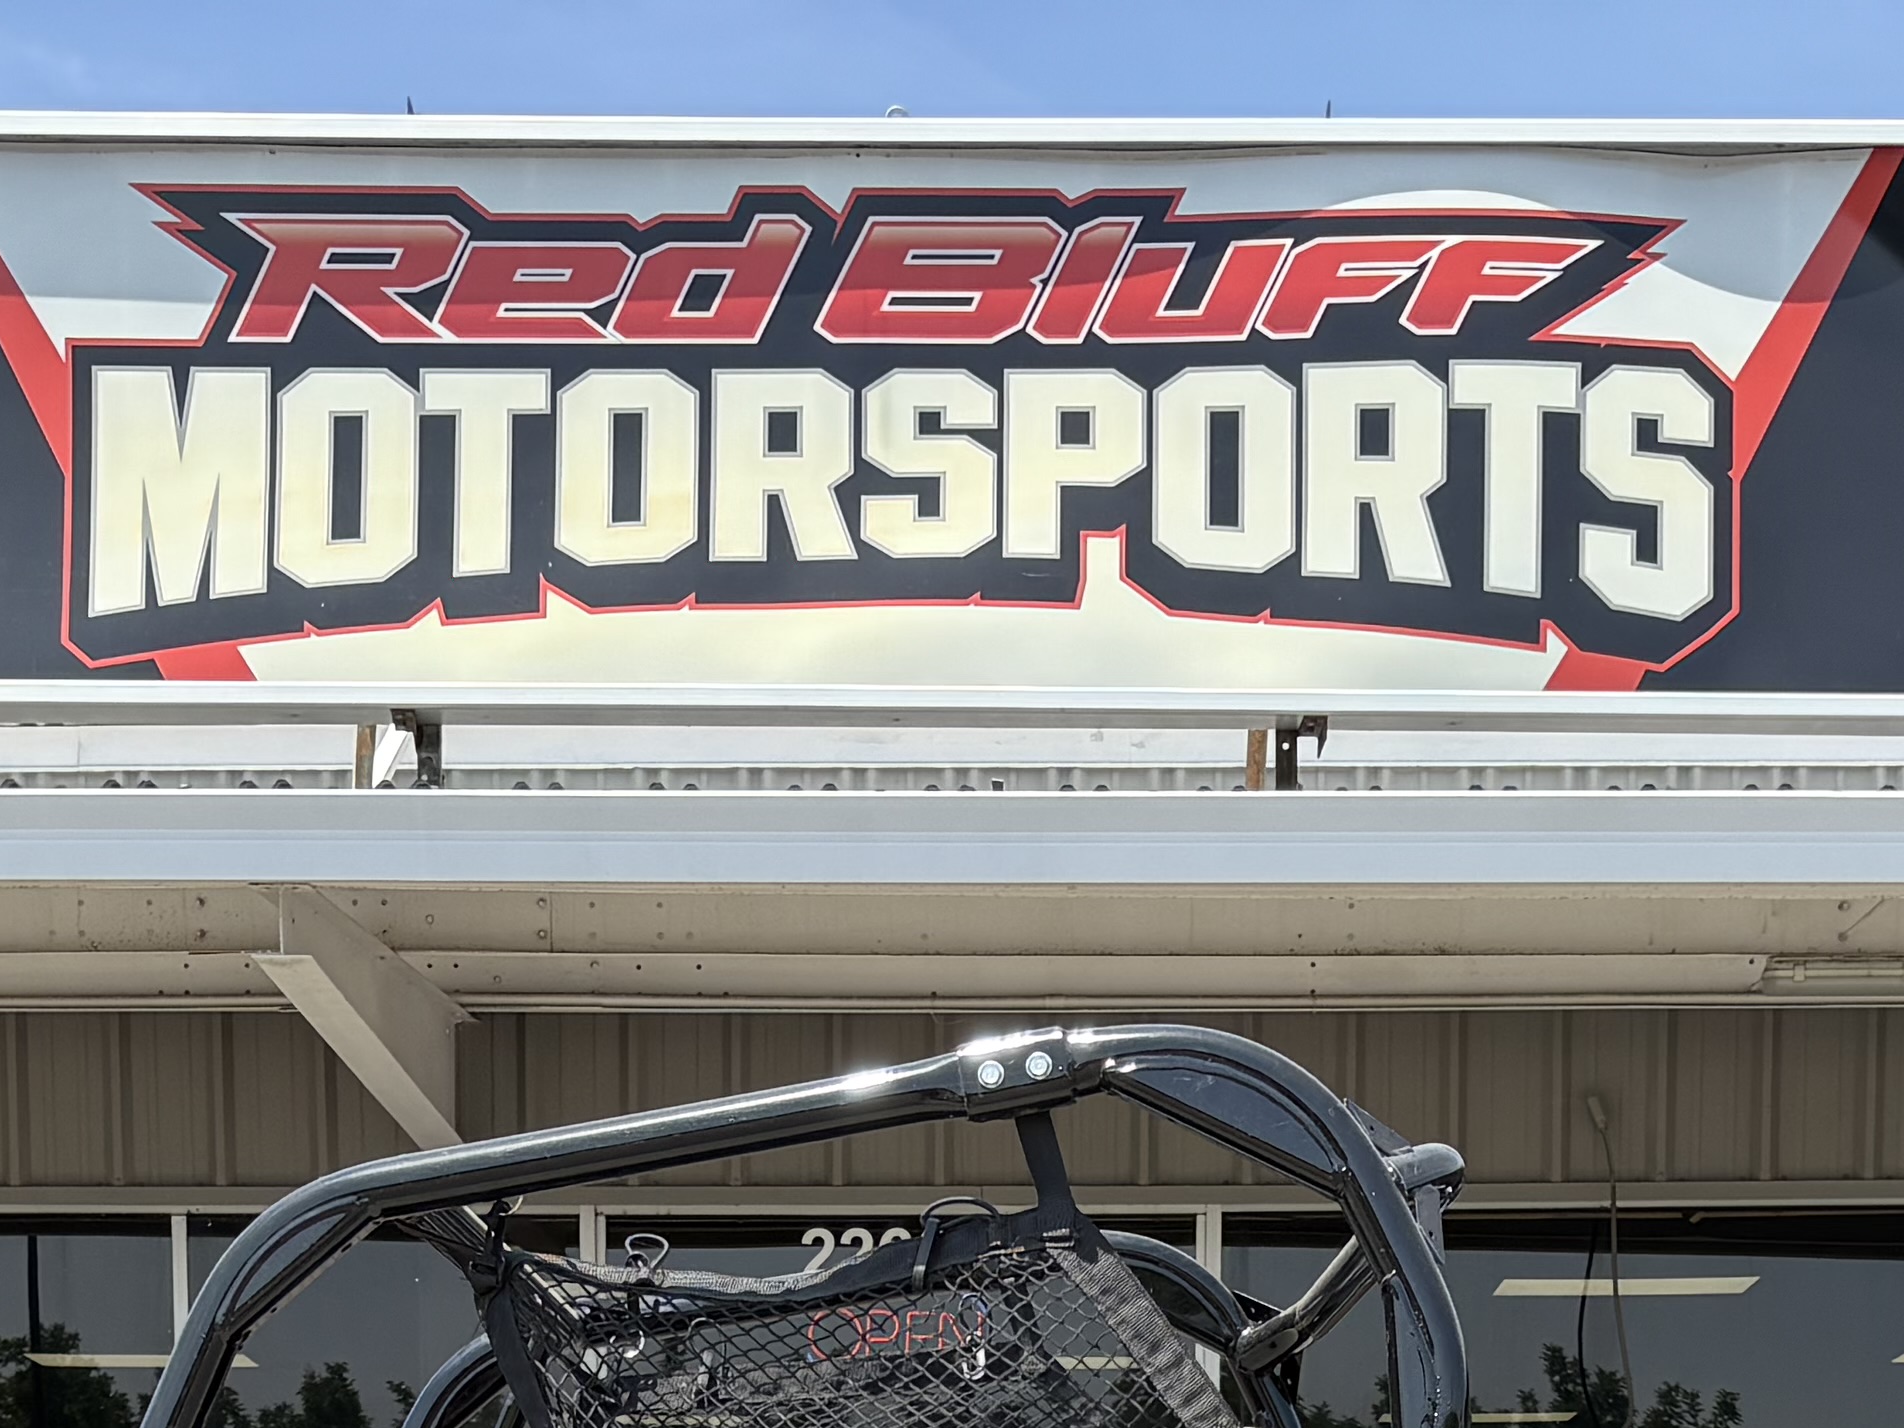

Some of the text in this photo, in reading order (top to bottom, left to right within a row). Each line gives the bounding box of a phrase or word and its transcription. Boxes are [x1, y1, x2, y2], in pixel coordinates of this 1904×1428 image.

[218, 213, 812, 344] Red
[88, 359, 1714, 621] MOTORSPORTS
[807, 1307, 984, 1359] OPEN
